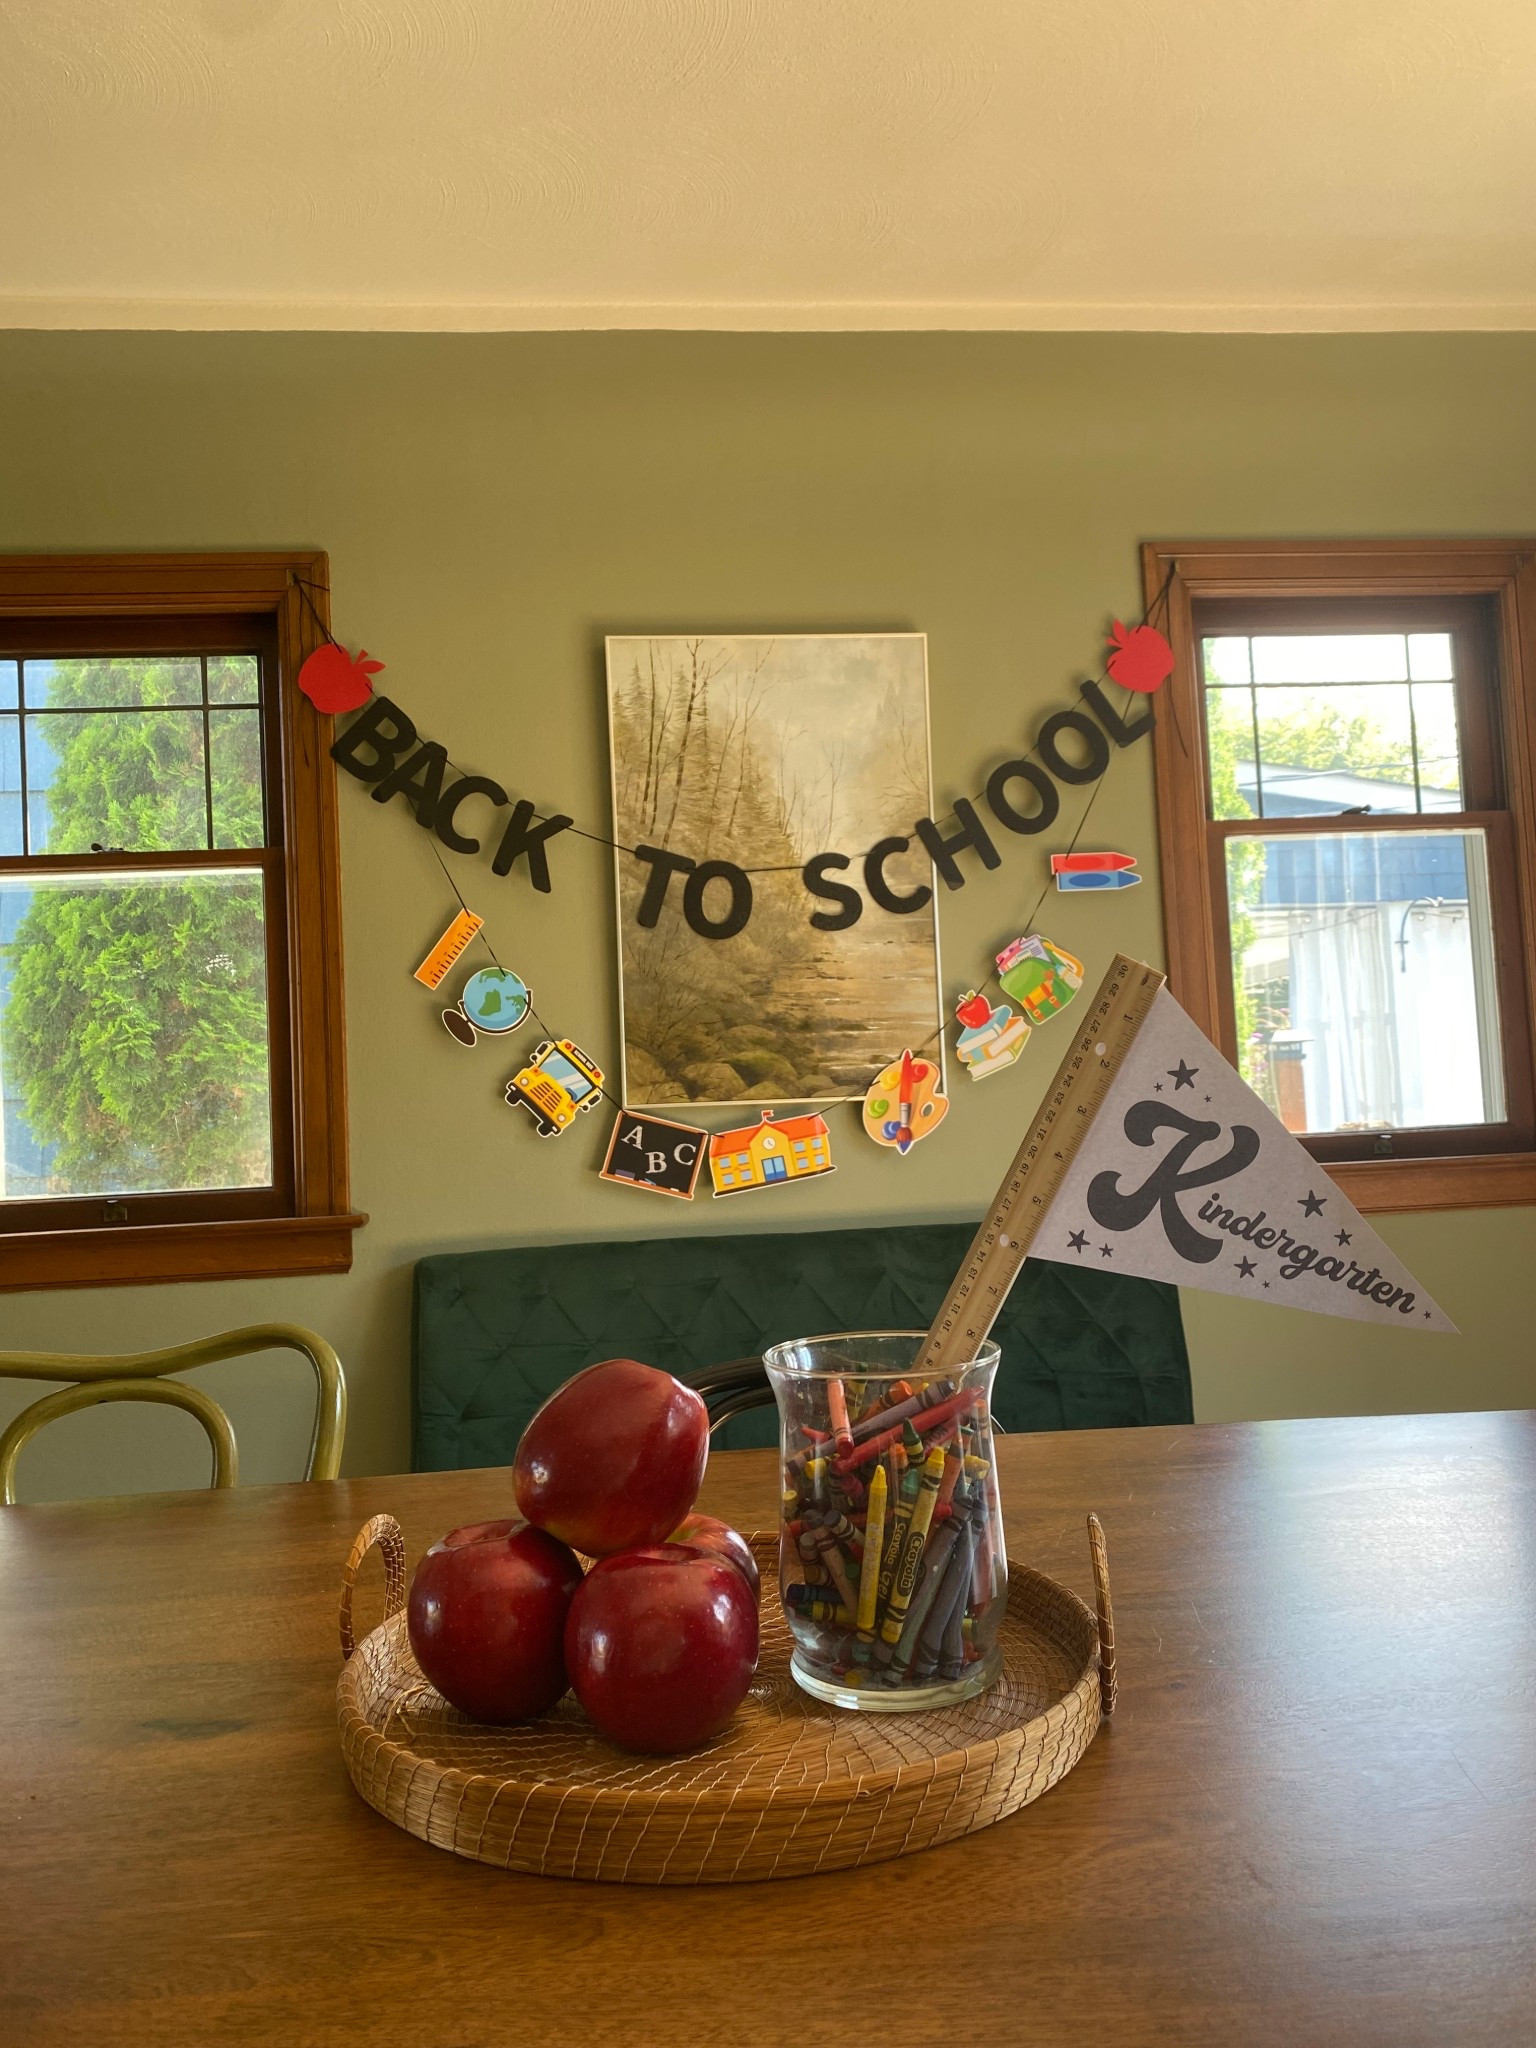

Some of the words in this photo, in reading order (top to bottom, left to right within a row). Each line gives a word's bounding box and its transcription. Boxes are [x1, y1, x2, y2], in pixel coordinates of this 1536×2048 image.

[330, 696, 573, 893] BACK
[635, 844, 752, 940] TO
[805, 680, 1155, 931] SCHOOL
[1100, 1059, 1110, 1068] 2
[1077, 1106, 1087, 1114] 3
[942, 1320, 952, 1332] 10
[951, 1303, 960, 1315] 11
[960, 1285, 969, 1297] 12
[968, 1268, 977, 1280] 13
[977, 1251, 986, 1263] 14
[985, 1233, 994, 1245] 15
[994, 1216, 1003, 1228] 16
[1003, 1198, 1012, 1210] 17
[1011, 1182, 1020, 1193] 18
[1020, 1164, 1029, 1176] 19
[1028, 1146, 1038, 1158] 20
[1037, 1128, 1046, 1140] 21
[1045, 1110, 1056, 1123] 22
[1054, 1092, 1064, 1105] 23
[1063, 1075, 1074, 1087] 24
[1072, 1056, 1083, 1070] 25
[1081, 1038, 1092, 1052] 26
[1090, 1020, 1101, 1033] 27
[1099, 1002, 1110, 1015] 28
[1109, 983, 1119, 997] 29
[1118, 965, 1128, 978] 30
[1032, 1196, 1041, 1204] 5
[1087, 1100, 1416, 1315] Kindergarten
[1011, 1241, 1019, 1249] 6
[989, 1286, 997, 1294] 7
[967, 1329, 975, 1337] 8
[887, 1523, 906, 1564] Crayola
[901, 1536, 923, 1588] Crayola
[878, 1571, 891, 1599] Gel
